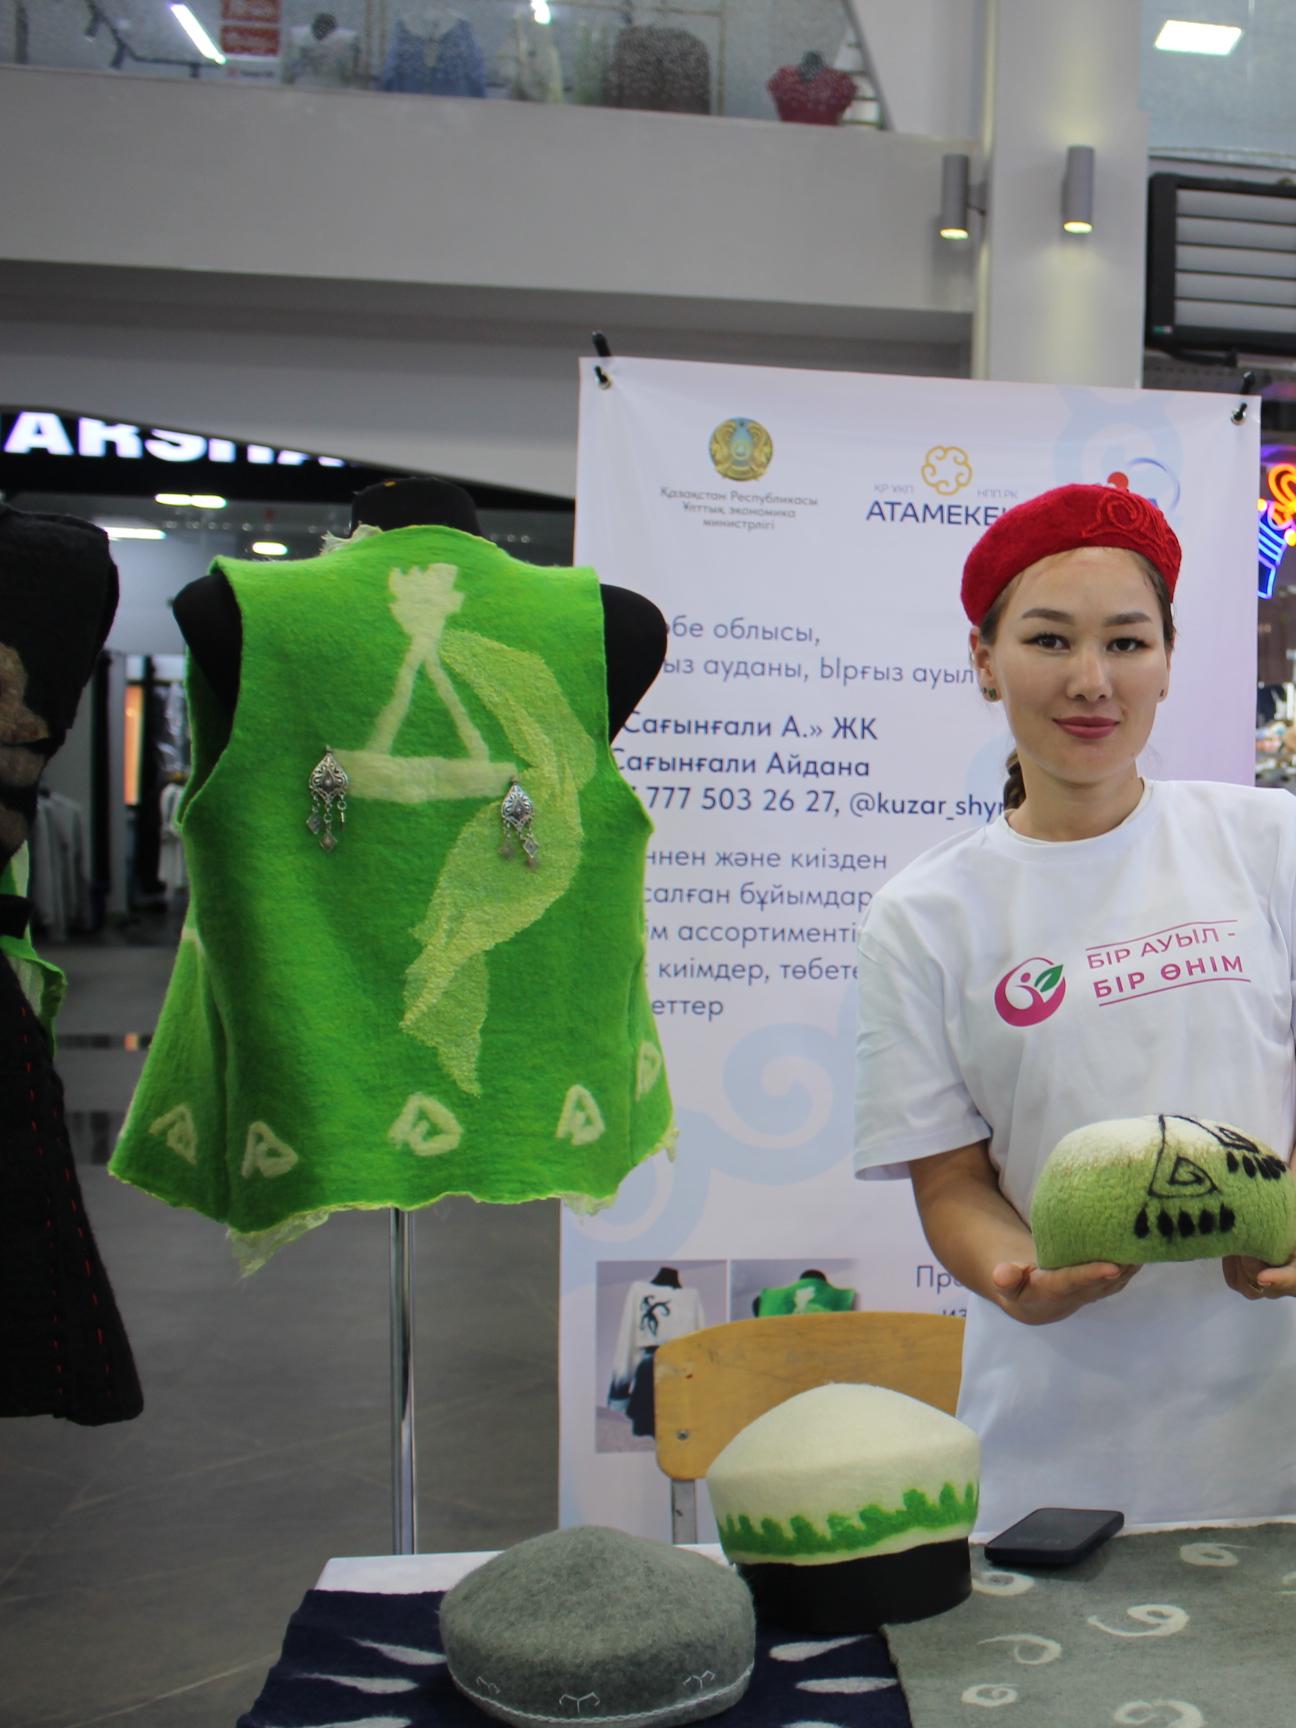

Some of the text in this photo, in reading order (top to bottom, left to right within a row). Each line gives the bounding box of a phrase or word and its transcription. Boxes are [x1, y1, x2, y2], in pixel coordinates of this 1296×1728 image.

[730, 490, 818, 506] Республикасы
[866, 500, 1006, 526] АТАМЕКЕ
[667, 614, 821, 646] бе облысы,
[703, 659, 809, 682] ауданы,
[819, 657, 904, 687] Ырғыз
[781, 715, 823, 739] А.»
[831, 716, 878, 741] ЖК
[766, 751, 870, 779] Айдана
[646, 786, 691, 810] 777
[702, 787, 752, 811] 503
[763, 789, 795, 812] 26
[805, 790, 841, 817] 27,
[714, 850, 782, 869] және
[790, 847, 888, 871] киізден
[740, 881, 873, 912] бұйымдар
[1087, 947, 1131, 970] БІР
[1140, 927, 1220, 957] АУЫЛ
[658, 956, 771, 986] киімдер,
[1093, 954, 1244, 999] БІР ӨНІМ
[651, 998, 724, 1022] еттер
